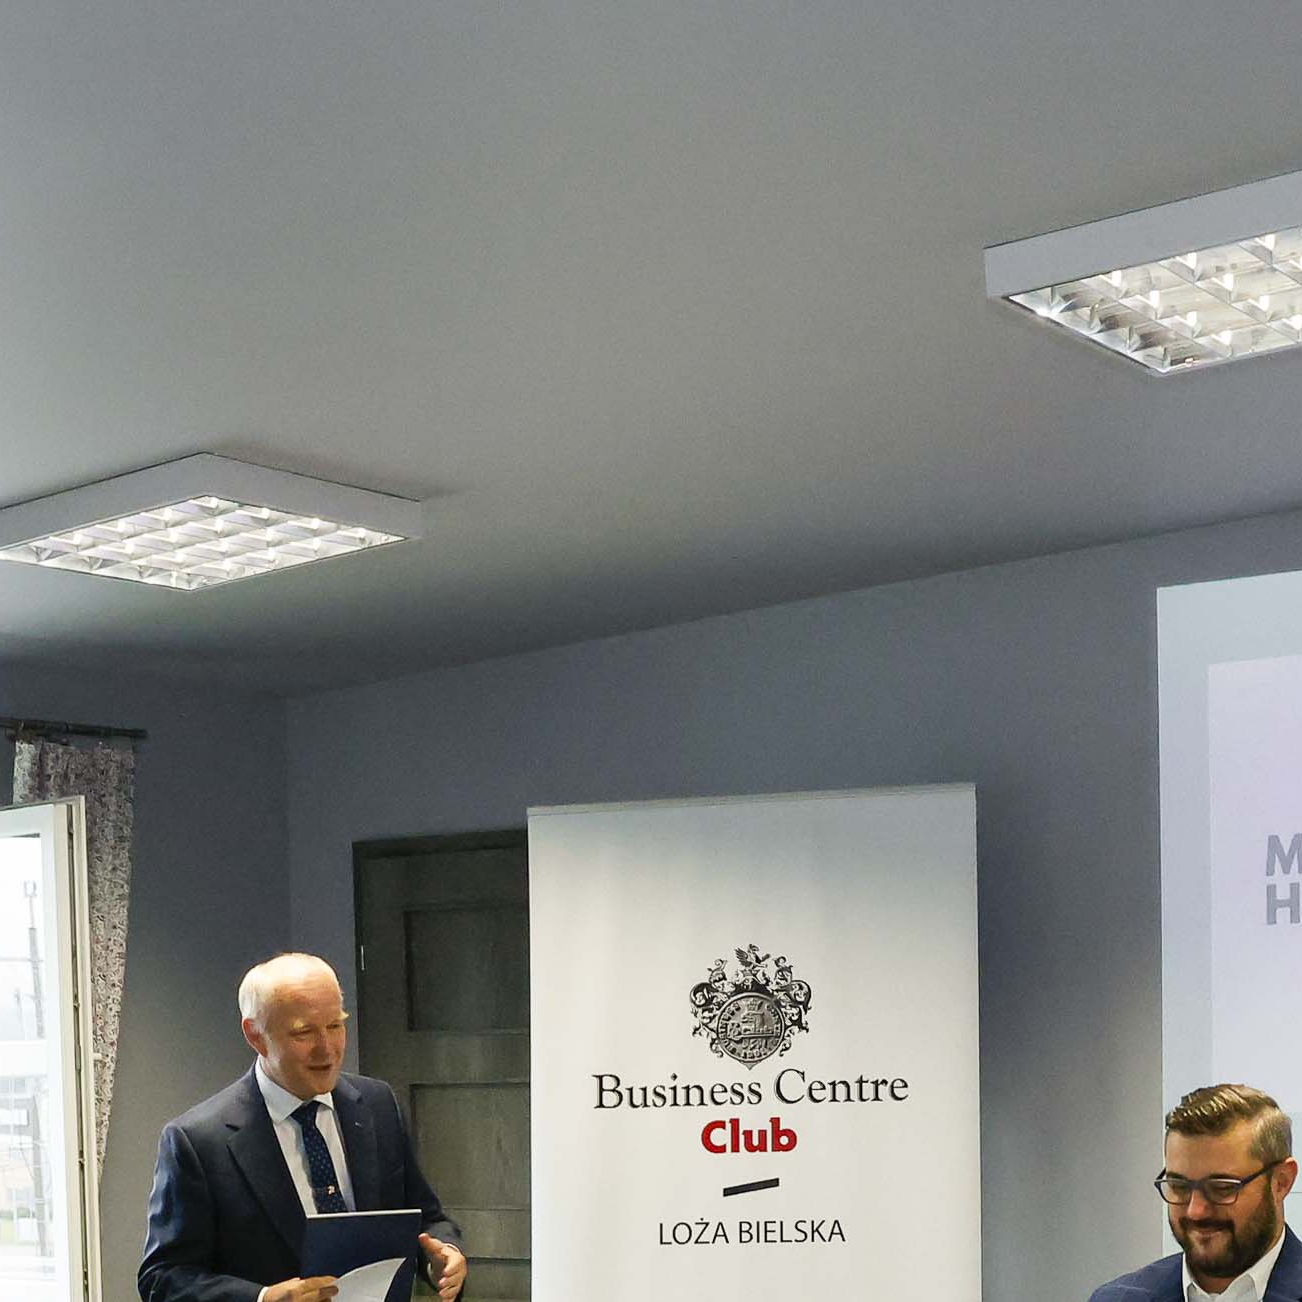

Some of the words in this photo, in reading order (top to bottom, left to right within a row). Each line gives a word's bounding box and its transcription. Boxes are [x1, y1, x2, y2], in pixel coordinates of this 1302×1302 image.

[591, 1072, 763, 1110] Business
[773, 1068, 910, 1105] Centre
[700, 1116, 798, 1154] Club
[659, 1217, 730, 1245] LOŻA
[738, 1219, 847, 1244] BIELSKA
